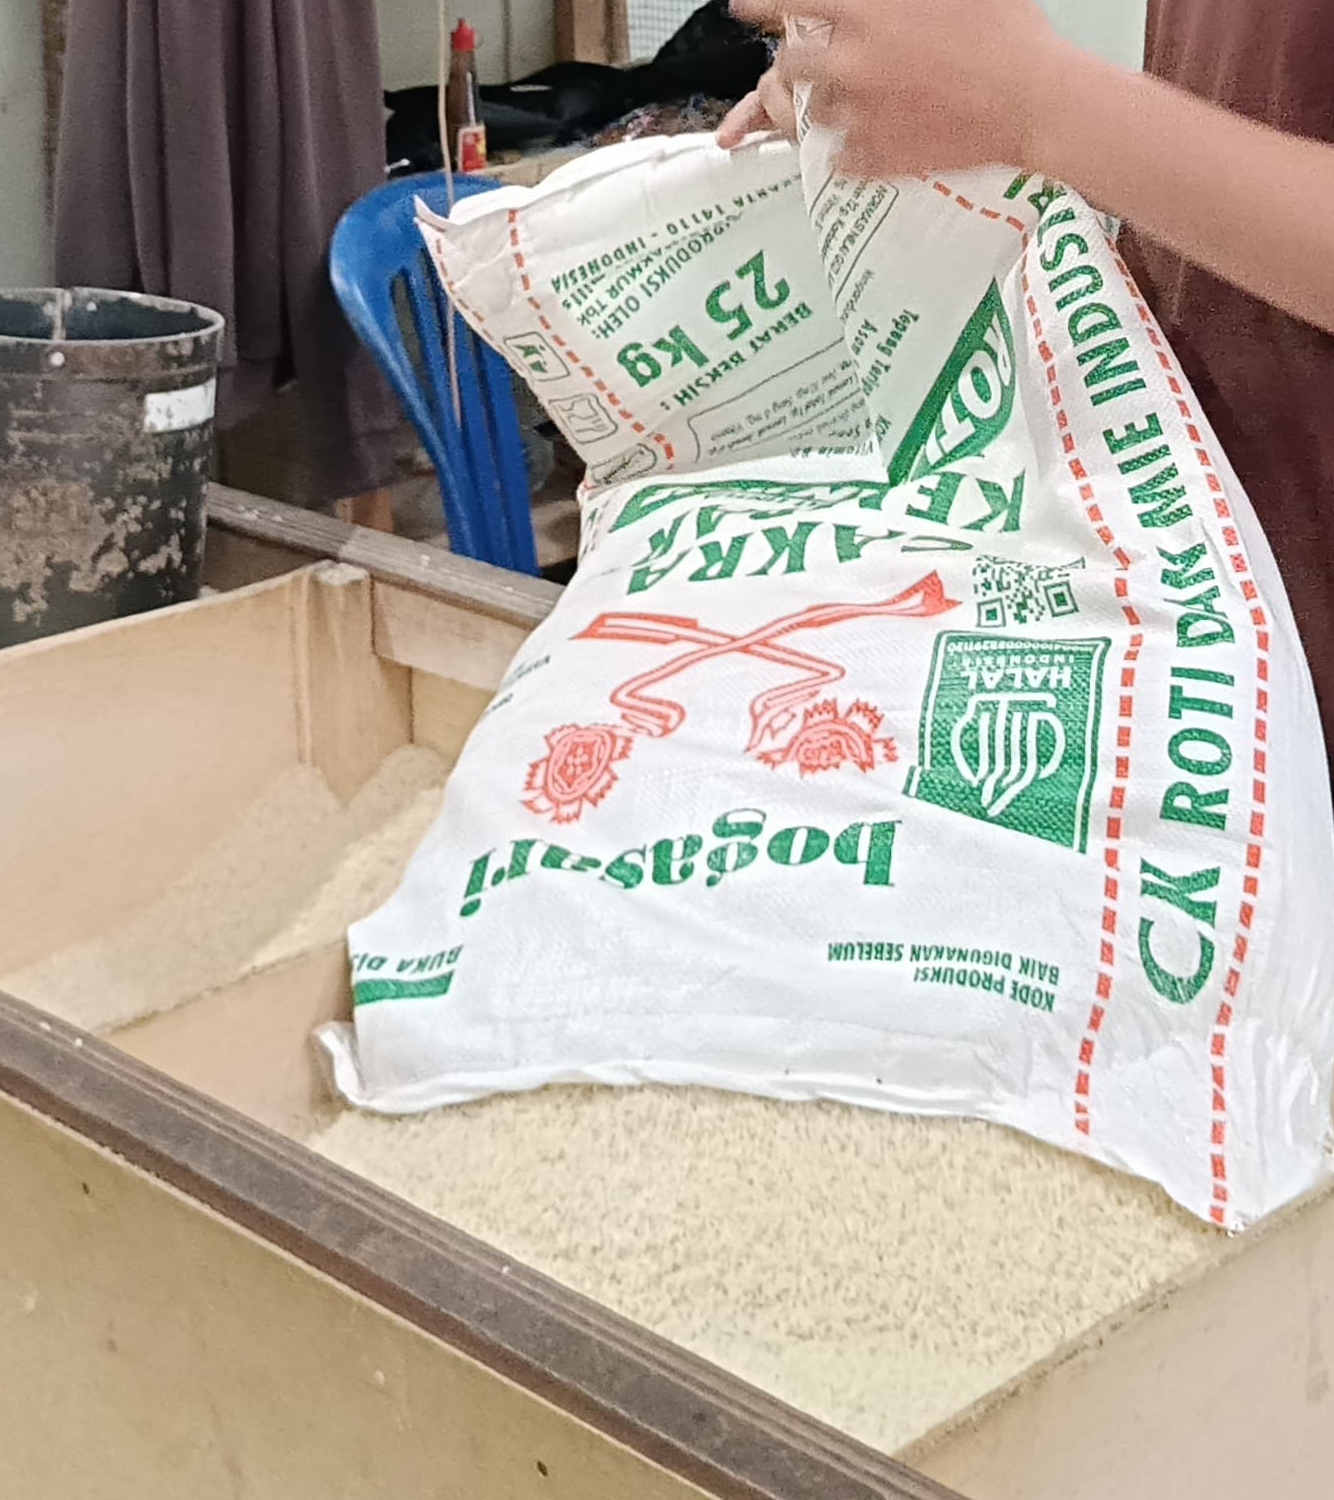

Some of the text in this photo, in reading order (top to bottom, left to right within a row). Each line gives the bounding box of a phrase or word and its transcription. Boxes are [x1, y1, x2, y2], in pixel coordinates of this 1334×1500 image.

[666, 203, 726, 237] 14110
[550, 236, 647, 294] INDONESIA
[576, 297, 609, 327] Tbk
[592, 297, 641, 340] OLEH:
[615, 249, 791, 387] 25 kg
[923, 308, 1016, 460] ROTI
[1102, 411, 1196, 531] MIE
[959, 666, 1072, 689] HALAL
[1157, 666, 1235, 833] ROTI
[460, 808, 903, 918] bogasari
[1137, 856, 1223, 1005] CK
[394, 943, 465, 974] BUKA
[826, 941, 1061, 986] BAIK DIGUNAKAN SEBELUM
[912, 966, 1056, 1013] KODE PRODUKSI
